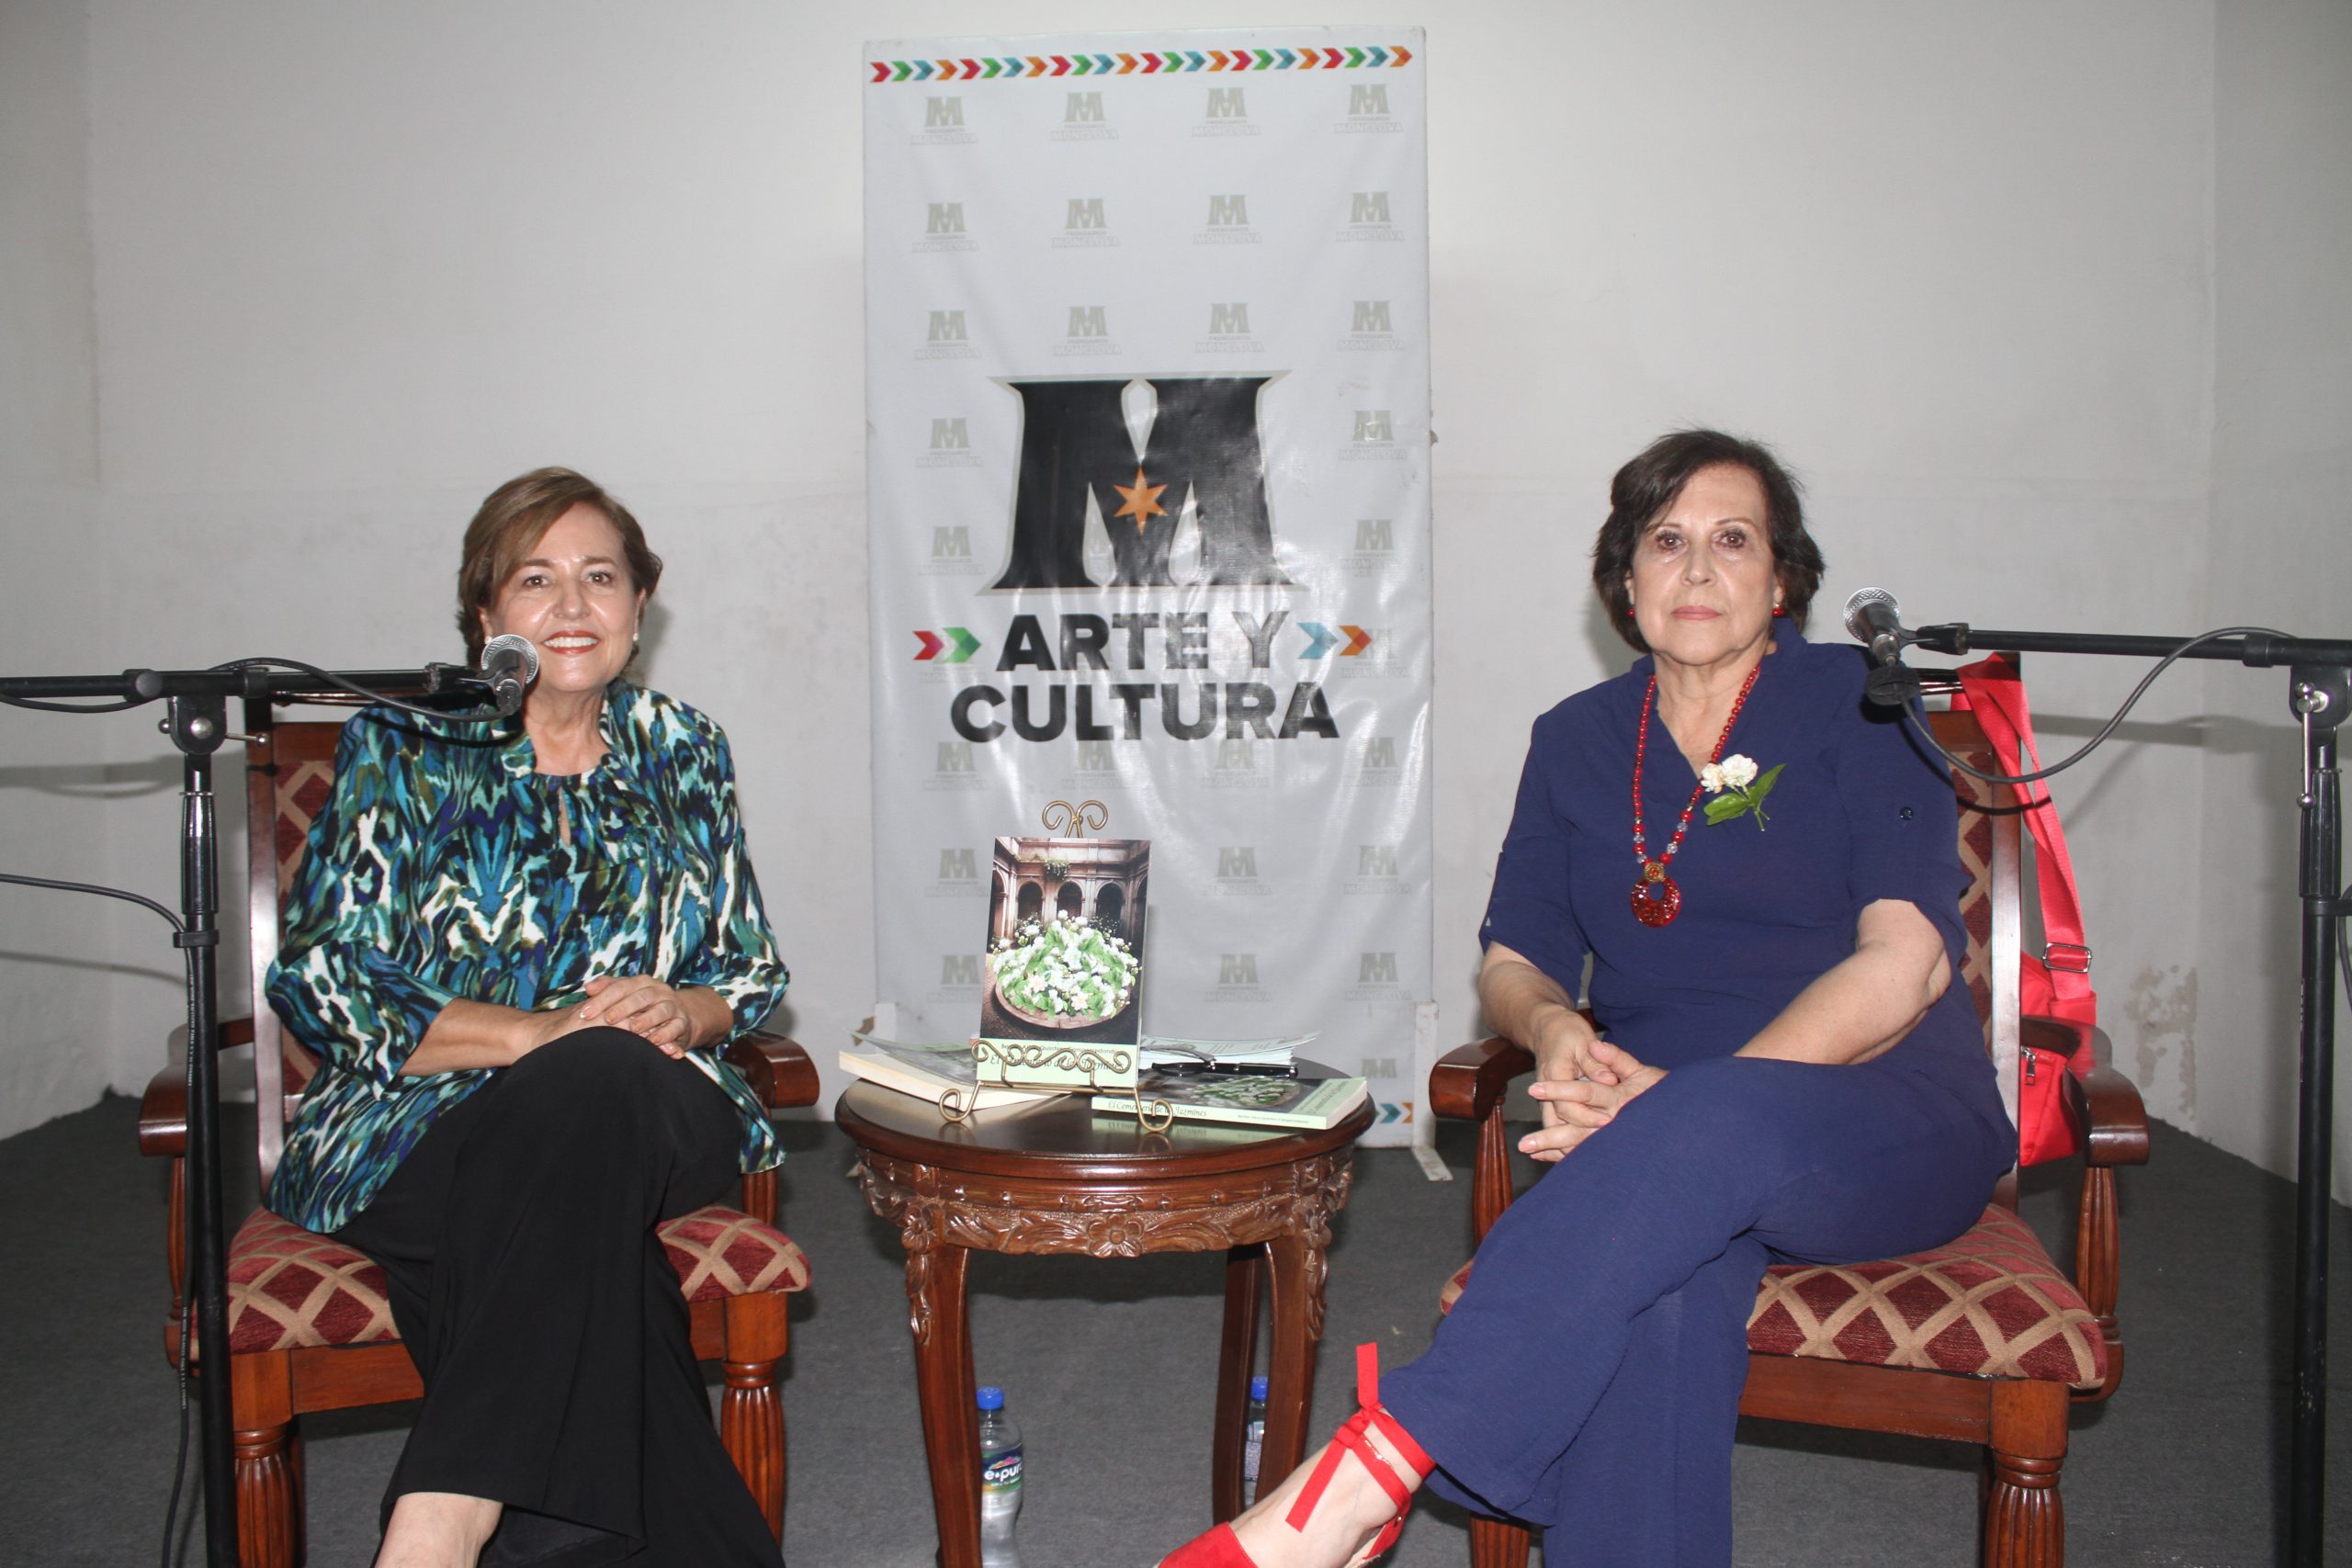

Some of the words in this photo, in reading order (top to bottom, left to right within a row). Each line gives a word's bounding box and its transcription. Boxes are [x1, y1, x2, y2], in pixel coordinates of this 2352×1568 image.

[923, 96, 966, 127] M
[1064, 92, 1106, 122] M
[1205, 87, 1248, 118] M
[1348, 84, 1390, 114] M
[925, 203, 967, 233] M
[1066, 198, 1108, 229] M
[1207, 195, 1250, 225] M
[1350, 192, 1392, 222] M
[926, 310, 968, 341] M
[1067, 306, 1109, 336] M
[1209, 303, 1251, 333] M
[1351, 301, 1393, 331] M
[929, 418, 971, 448] M
[978, 372, 1306, 594] M
[929, 525, 971, 556] M
[1353, 520, 1396, 550] M
[996, 612, 1208, 671] ARTE
[1233, 611, 1290, 669] Y
[951, 682, 1340, 743] CULTURA
[934, 742, 977, 772] M
[1075, 741, 1117, 772] M
[936, 848, 978, 878] M
[1216, 847, 1259, 877] M
[1357, 845, 1399, 875] M
[939, 954, 981, 985] M
[1217, 953, 1260, 984] M
[1357, 952, 1399, 982] M
